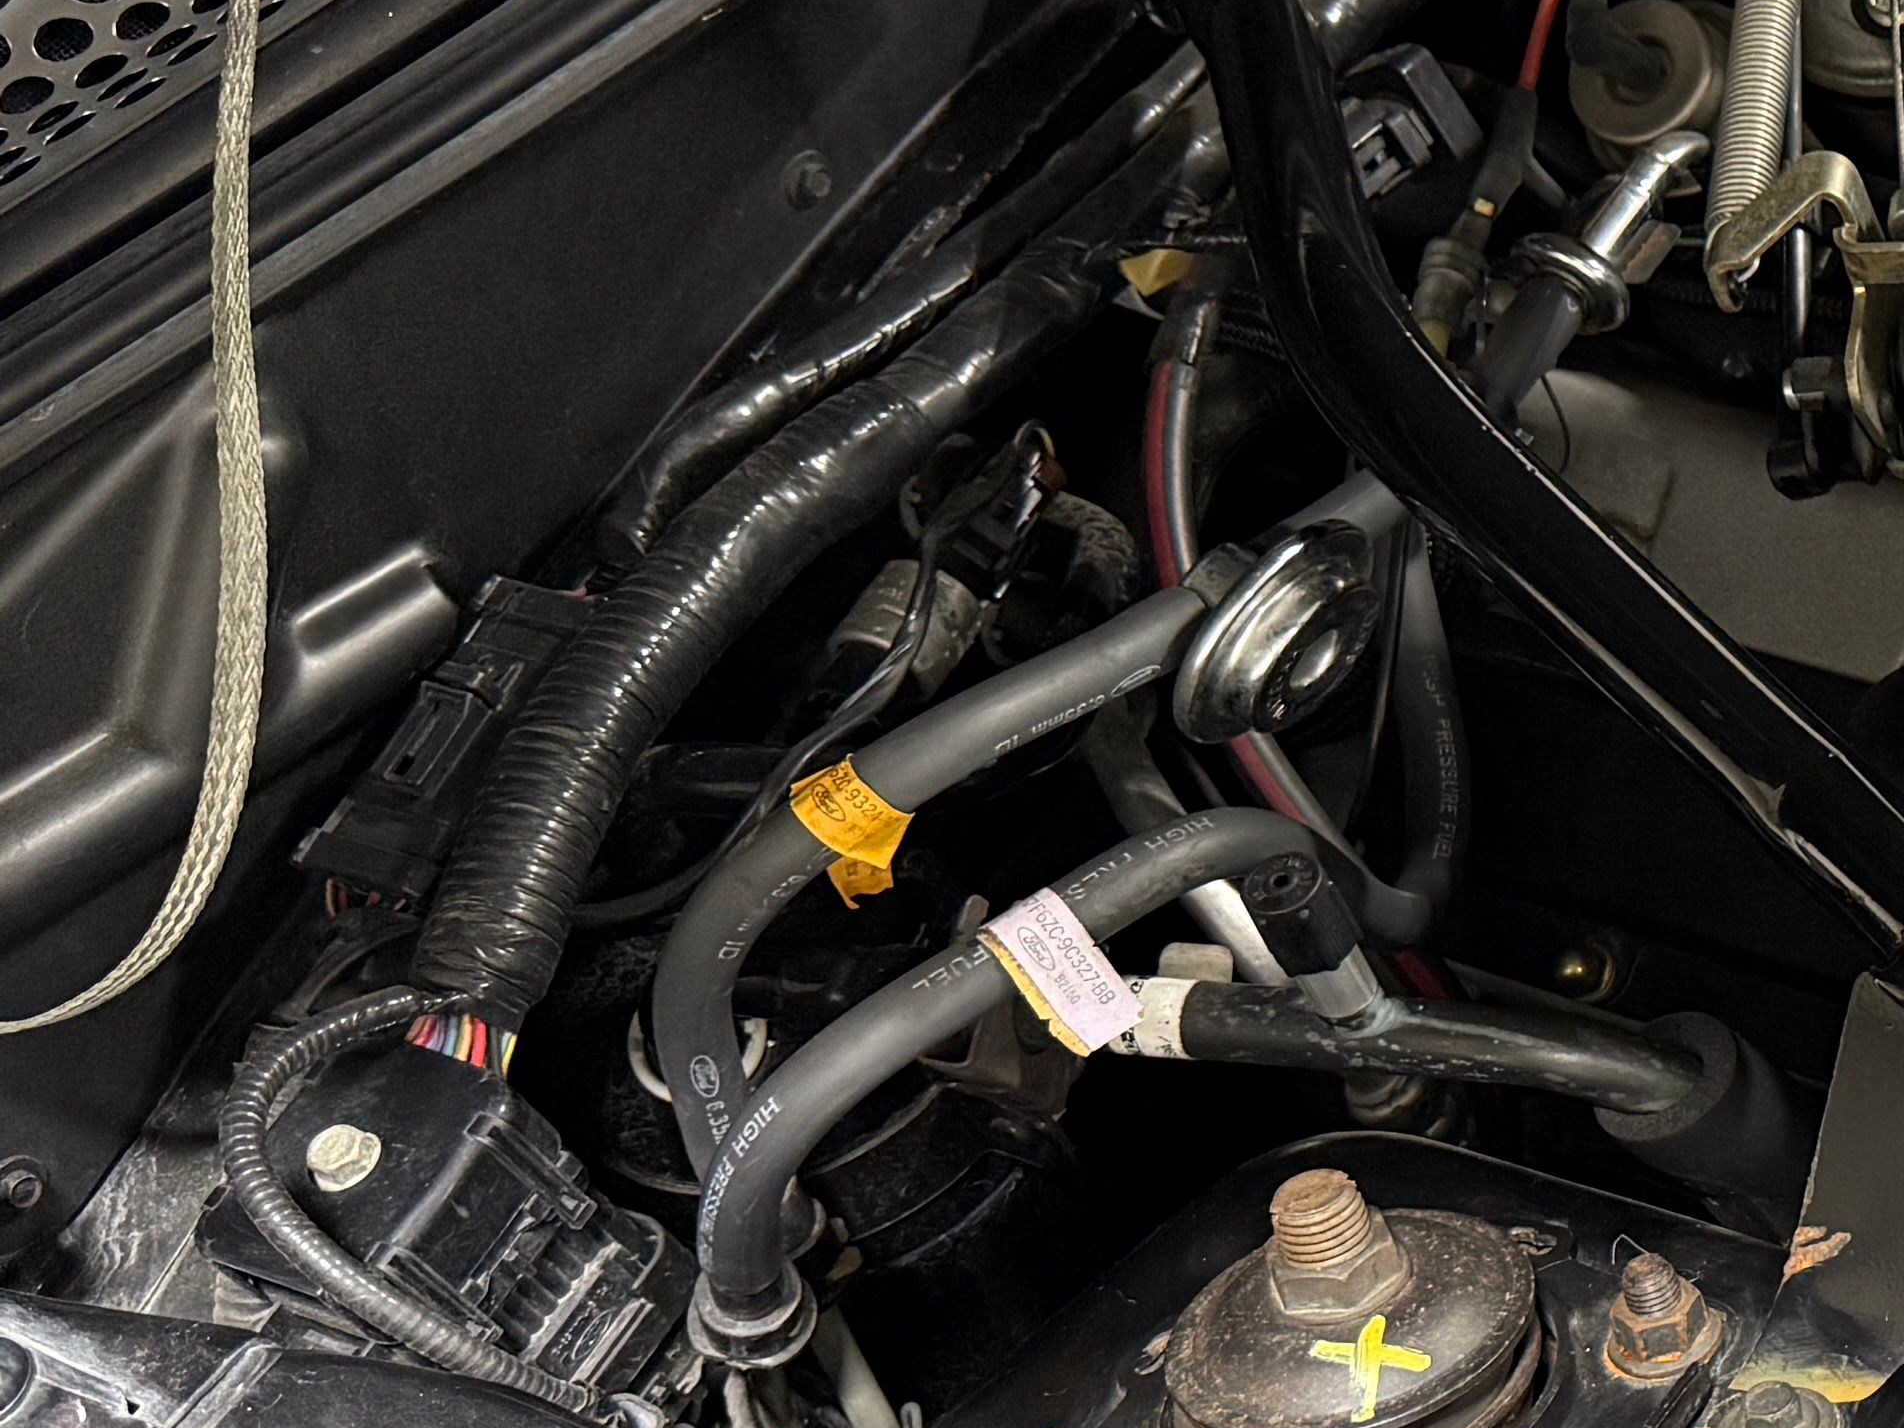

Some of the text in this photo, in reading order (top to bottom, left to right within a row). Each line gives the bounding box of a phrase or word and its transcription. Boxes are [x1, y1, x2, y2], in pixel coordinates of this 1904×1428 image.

[1142, 814, 1214, 853] HIGH
[910, 943, 989, 992] FUEL
[704, 1101, 729, 1144] 6.35
[729, 1095, 780, 1158] HIGH
